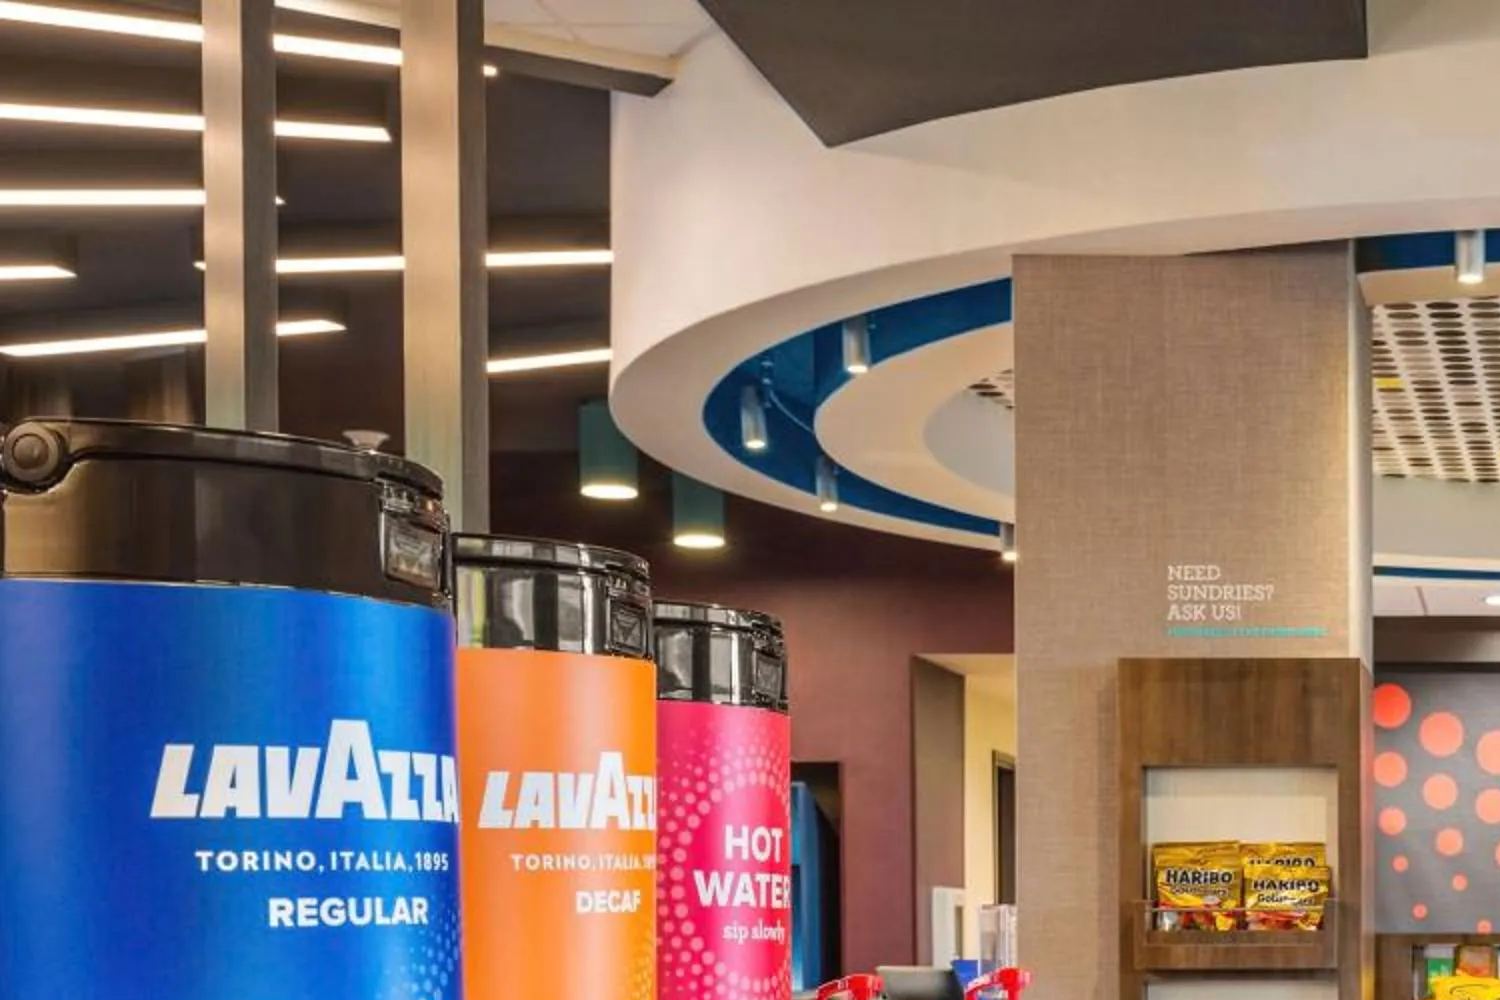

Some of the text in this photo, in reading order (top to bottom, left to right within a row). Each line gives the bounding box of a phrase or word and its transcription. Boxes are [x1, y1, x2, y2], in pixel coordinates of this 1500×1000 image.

[1168, 565, 1221, 581] NEED
[1167, 585, 1275, 601] SUNDRIES?
[1167, 604, 1242, 620] ASK US!
[150, 718, 459, 823] LAVAZZA
[478, 751, 657, 830] LAVAZZ
[725, 824, 782, 863] HOT
[195, 850, 449, 873] TORINO, ITALIA, 1895
[511, 853, 596, 871] TORINO,
[692, 869, 792, 909] WATER
[1165, 869, 1234, 886] HARIBO
[267, 896, 429, 928] REGULAR
[575, 889, 641, 913] DECAF
[723, 918, 785, 945] sip slowly
